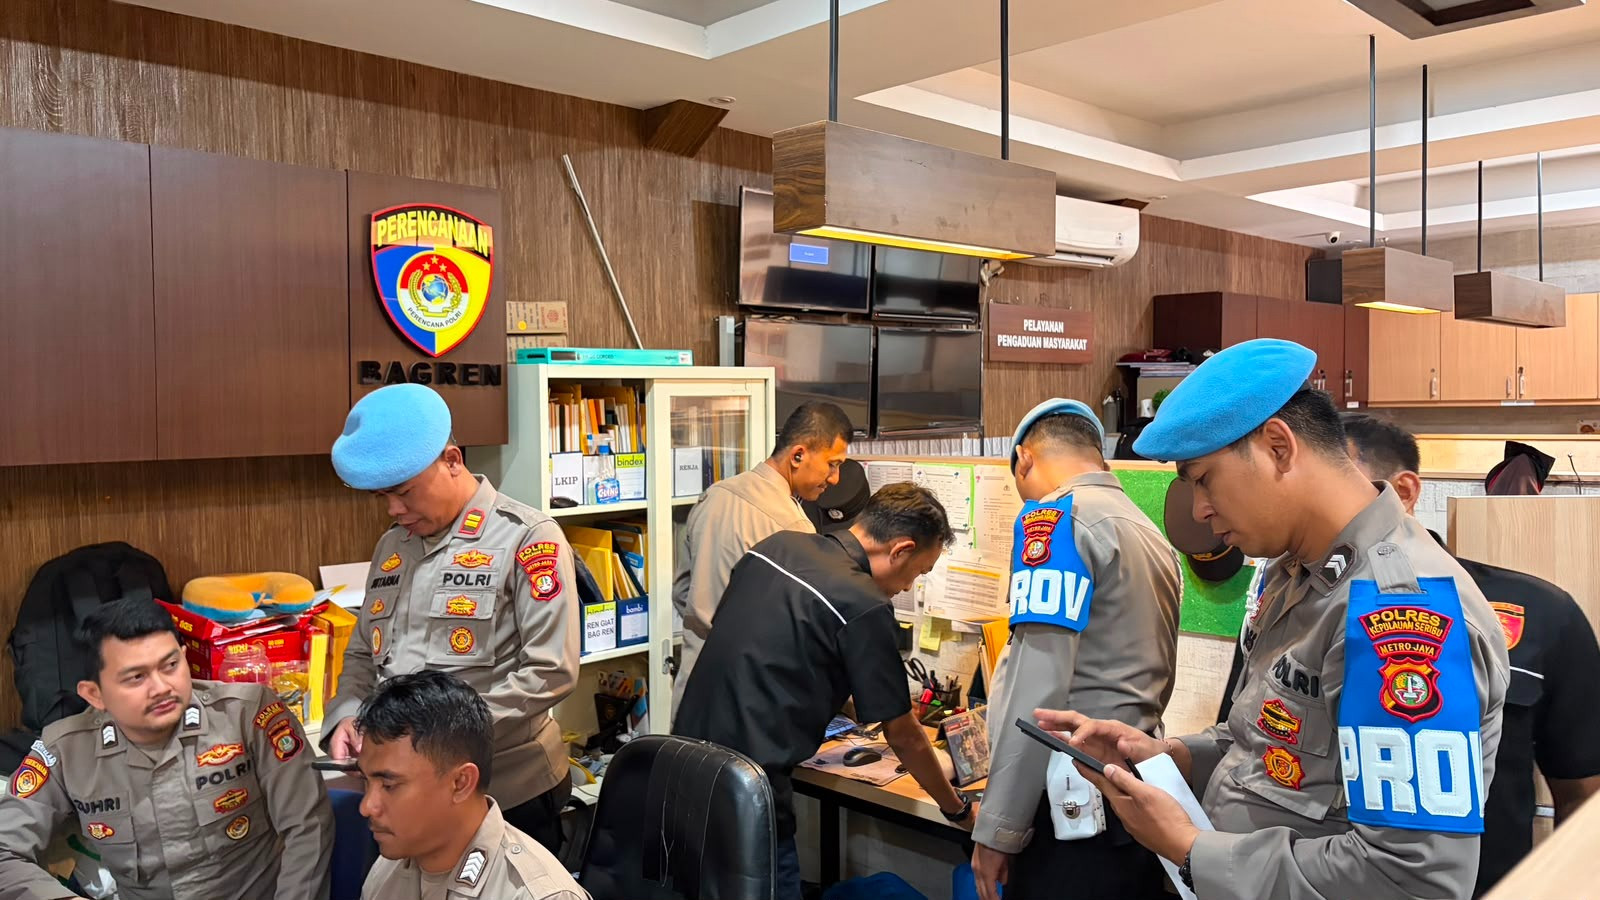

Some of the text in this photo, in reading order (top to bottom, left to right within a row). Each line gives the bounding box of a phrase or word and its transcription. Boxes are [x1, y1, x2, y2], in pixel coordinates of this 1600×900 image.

[377, 210, 488, 257] PERENCANAAN
[408, 307, 462, 327] PERENCANA POLRI
[1023, 319, 1064, 333] PELAYANAN
[997, 334, 1088, 350] PENGADUAN MASYARAKAT
[357, 360, 502, 386] BAGREN
[617, 455, 643, 467] bindex
[555, 476, 579, 486] LKIP
[518, 543, 556, 562] POLRES
[442, 572, 492, 587] POLRI
[626, 603, 643, 614] bambi
[586, 617, 615, 630] REN GIAT
[1369, 609, 1441, 627] POLRES
[587, 627, 615, 639] BAG REN
[1369, 620, 1443, 637] KEPULAUAN SERIBU
[195, 759, 252, 791] POLRI
